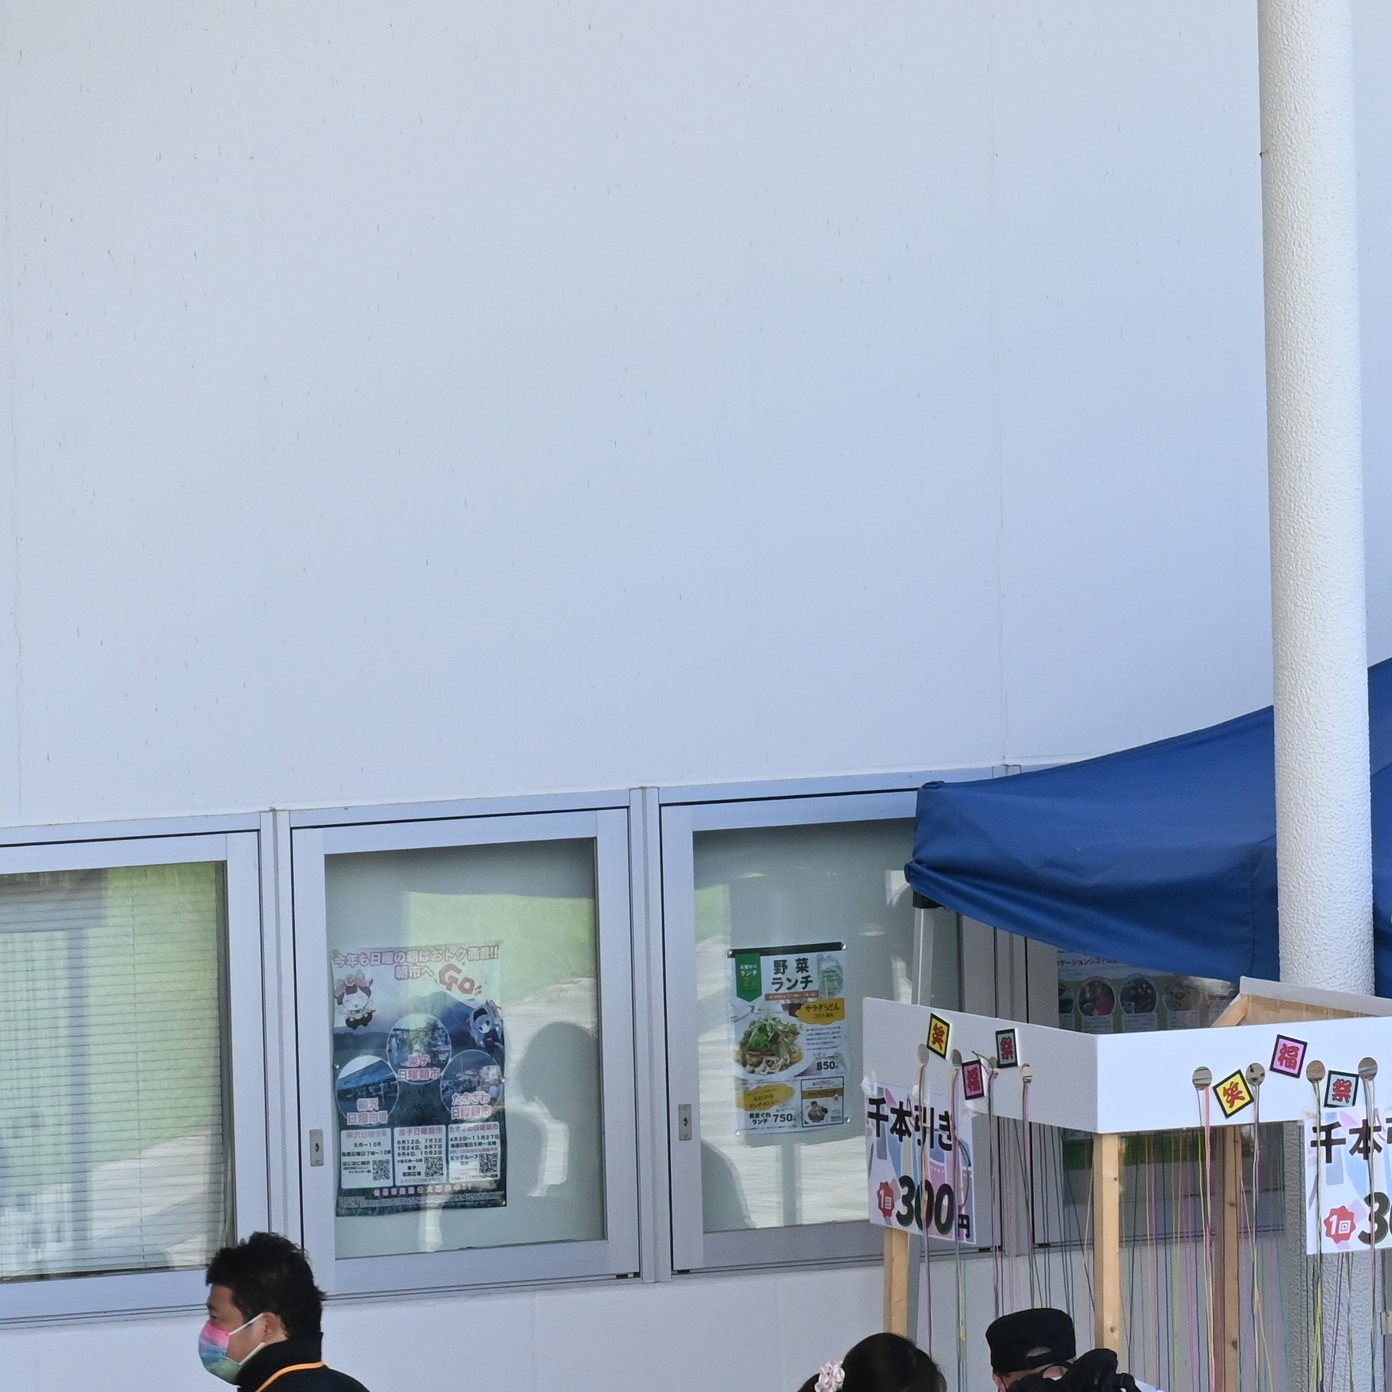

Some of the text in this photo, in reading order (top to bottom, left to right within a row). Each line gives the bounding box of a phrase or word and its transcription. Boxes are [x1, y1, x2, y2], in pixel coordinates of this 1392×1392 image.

[771, 974, 814, 992] ランチ
[1276, 1042, 1301, 1071] 福
[1331, 1077, 1353, 1104] 祭
[867, 1096, 954, 1152] 千本引き
[895, 1174, 971, 1240] 300円
[1328, 1213, 1351, 1235] 1回
